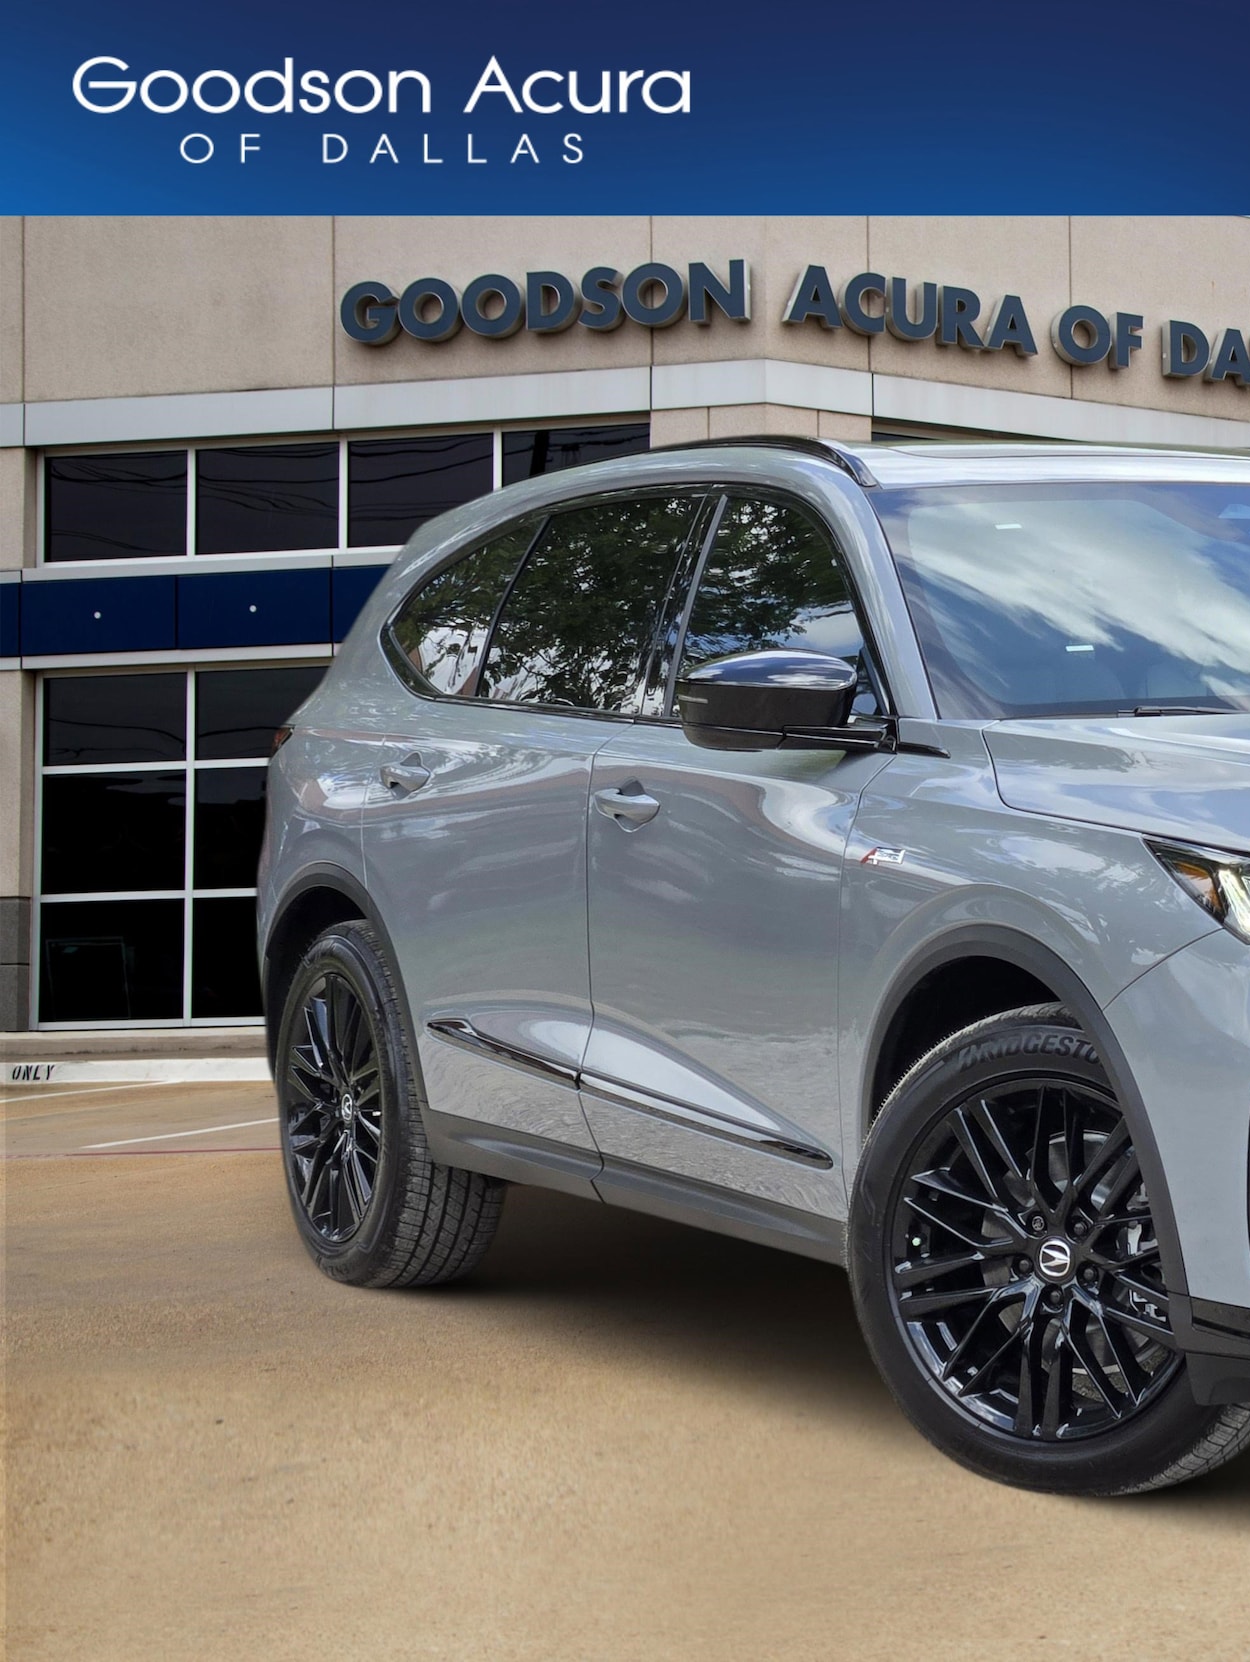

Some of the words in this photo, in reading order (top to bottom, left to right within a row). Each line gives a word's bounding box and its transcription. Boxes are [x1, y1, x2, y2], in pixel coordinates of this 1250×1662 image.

[340, 258, 752, 346] GOODSON
[782, 264, 1039, 357] ACURA
[1050, 304, 1144, 367] OF
[12, 1064, 55, 1081] ONLY
